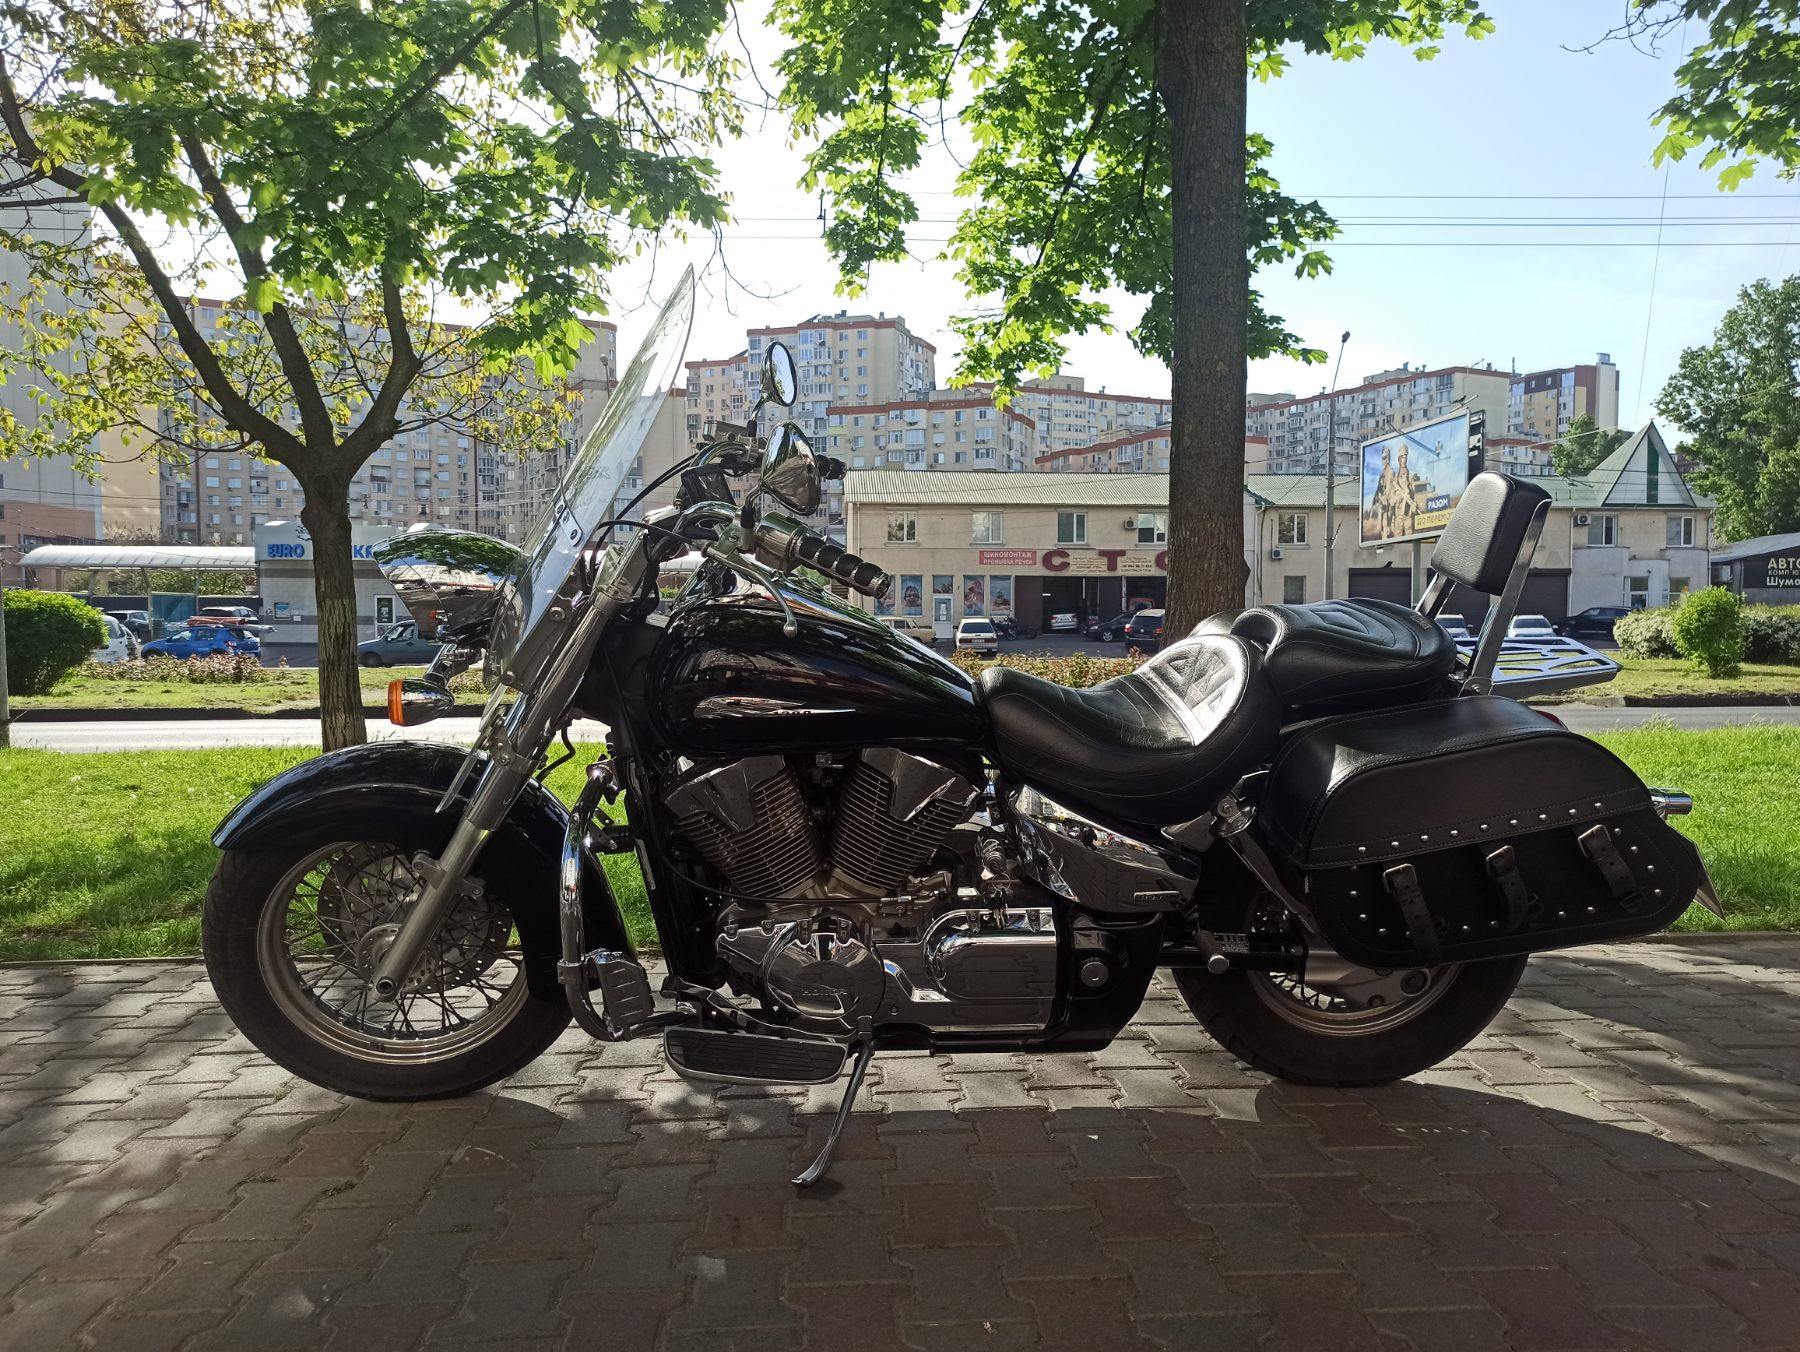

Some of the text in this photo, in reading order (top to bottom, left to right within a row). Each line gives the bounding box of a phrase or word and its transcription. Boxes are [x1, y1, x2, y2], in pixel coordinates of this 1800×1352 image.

[1427, 498, 1449, 510] РАЗОМ
[1417, 512, 1453, 526] ДО ПЕРЕМО
[267, 543, 305, 558] EURO
